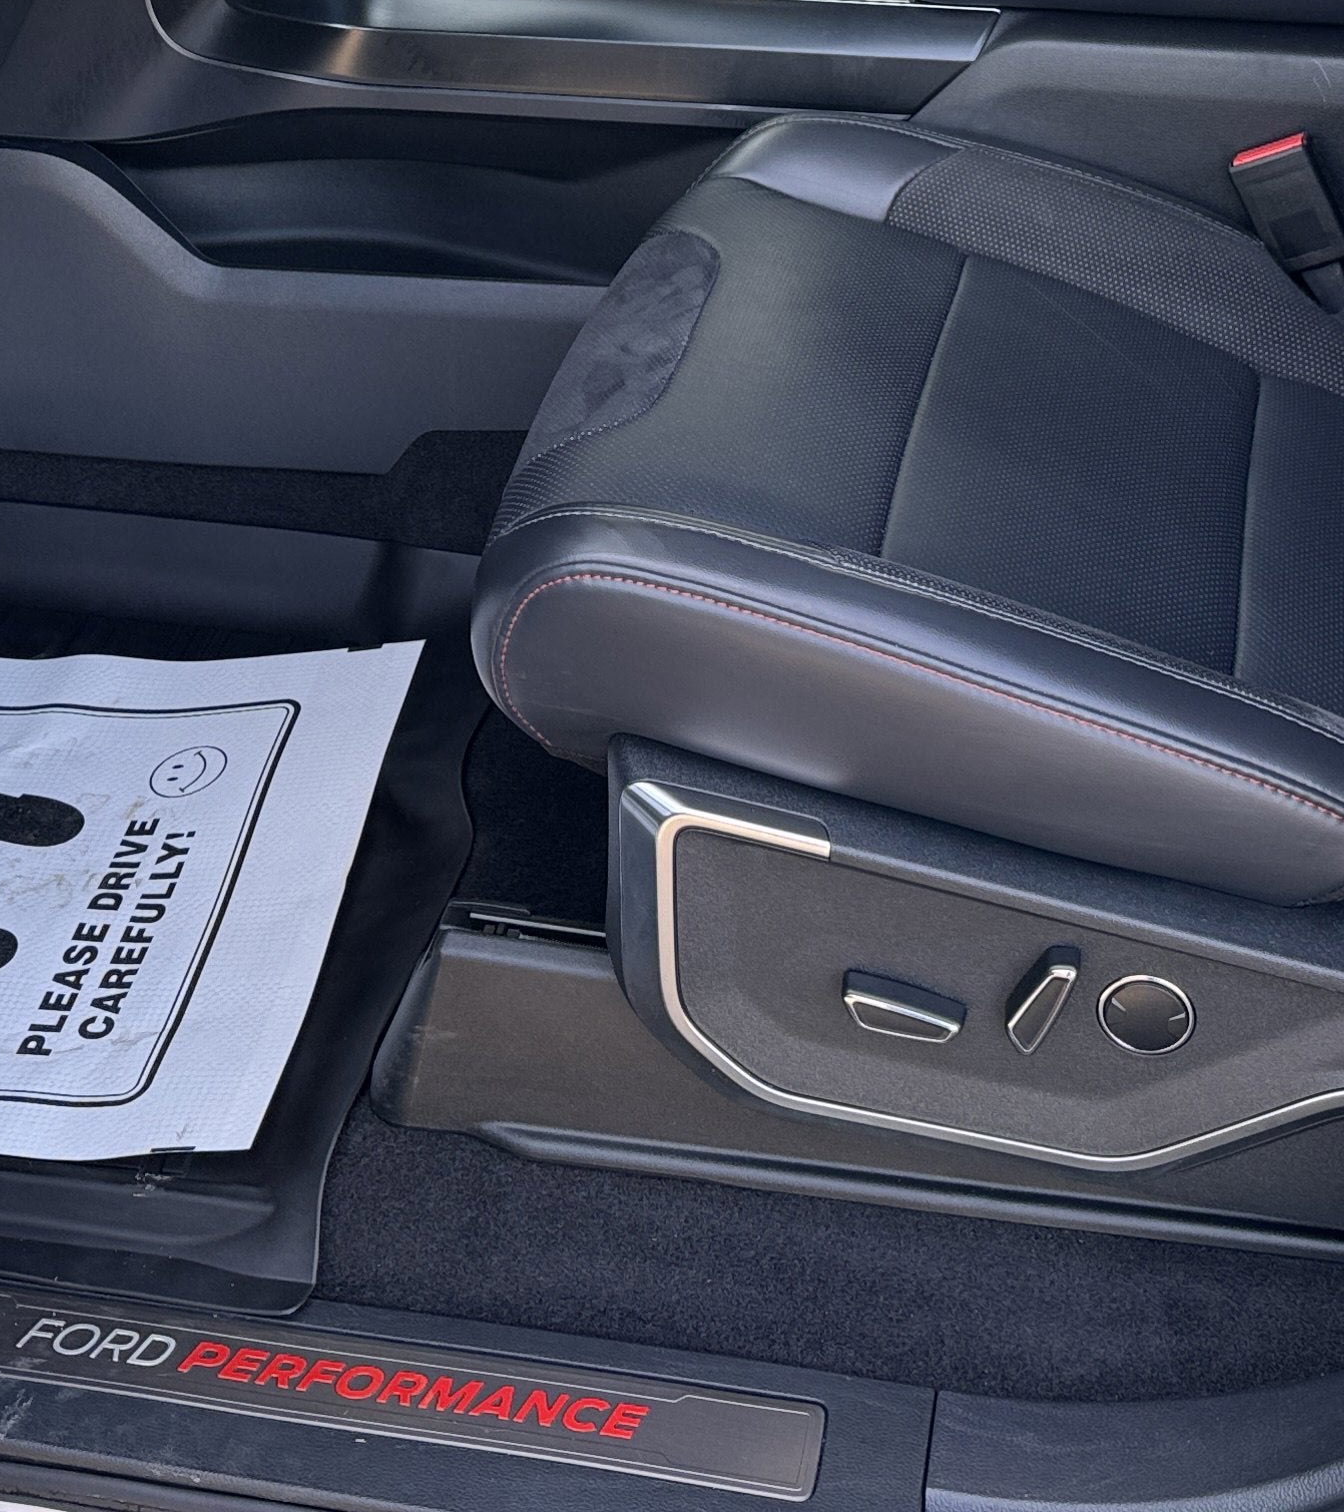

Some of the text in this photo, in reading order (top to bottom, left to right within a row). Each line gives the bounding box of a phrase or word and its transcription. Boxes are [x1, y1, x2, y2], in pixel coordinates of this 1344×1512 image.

[16, 817, 160, 1057] PLEASE DRIVE
[77, 830, 197, 1040] CAREFULLY!
[16, 1317, 652, 1441] FORD PERFORMANCE
